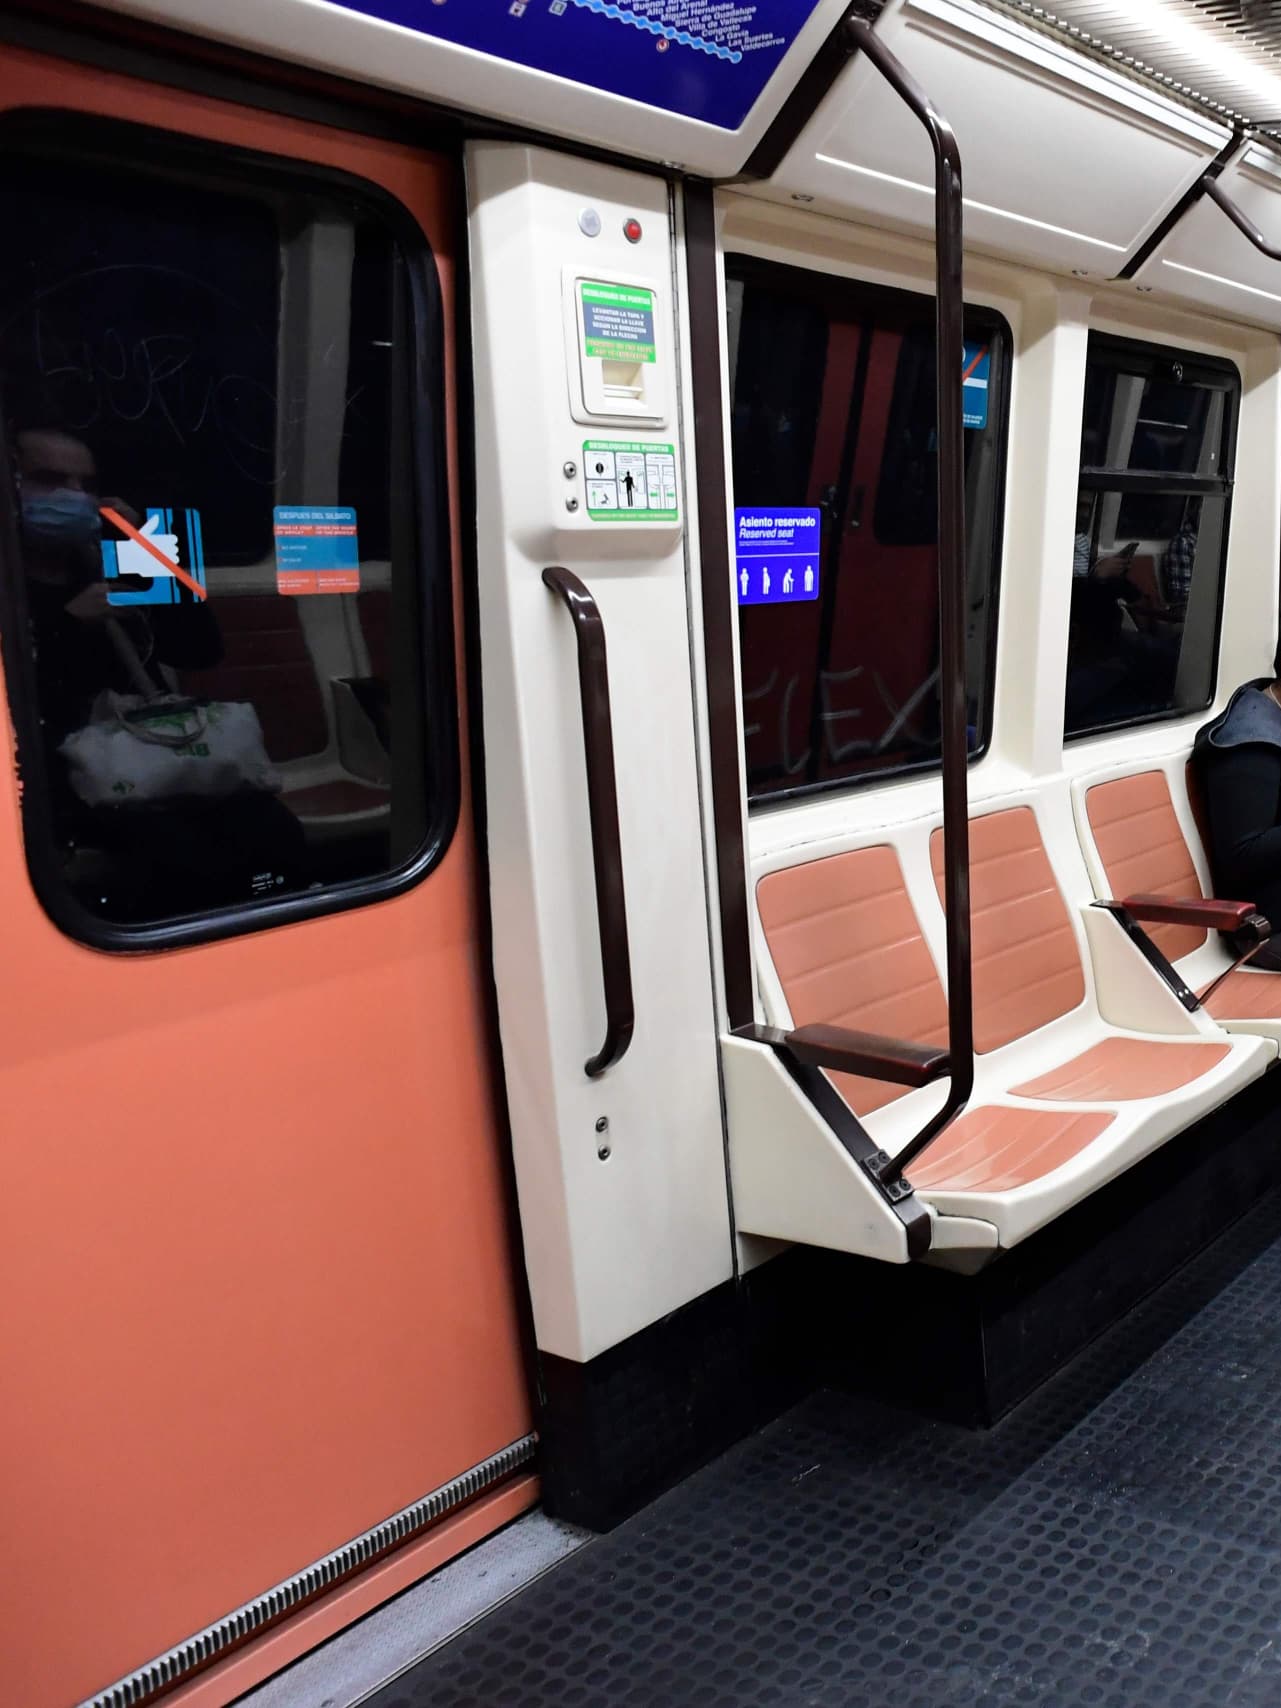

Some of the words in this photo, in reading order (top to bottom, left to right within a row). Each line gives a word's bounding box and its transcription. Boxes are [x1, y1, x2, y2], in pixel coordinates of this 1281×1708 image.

[647, 7, 664, 16] Alto
[665, 4, 679, 13] del
[661, 9, 689, 21] Miguel
[701, 14, 712, 22] de
[714, 6, 757, 21] Guadalupe
[689, 22, 706, 32] Villa
[707, 20, 718, 29] de
[720, 14, 752, 26] Vallecas
[702, 24, 741, 38] Congosto
[715, 34, 725, 42] La
[727, 29, 749, 40] Gavia
[741, 37, 785, 51] Valdecarros
[739, 516, 773, 528] Asiento
[774, 515, 817, 527] reservado
[739, 528, 777, 538] Reserved
[777, 527, 795, 538] seat
